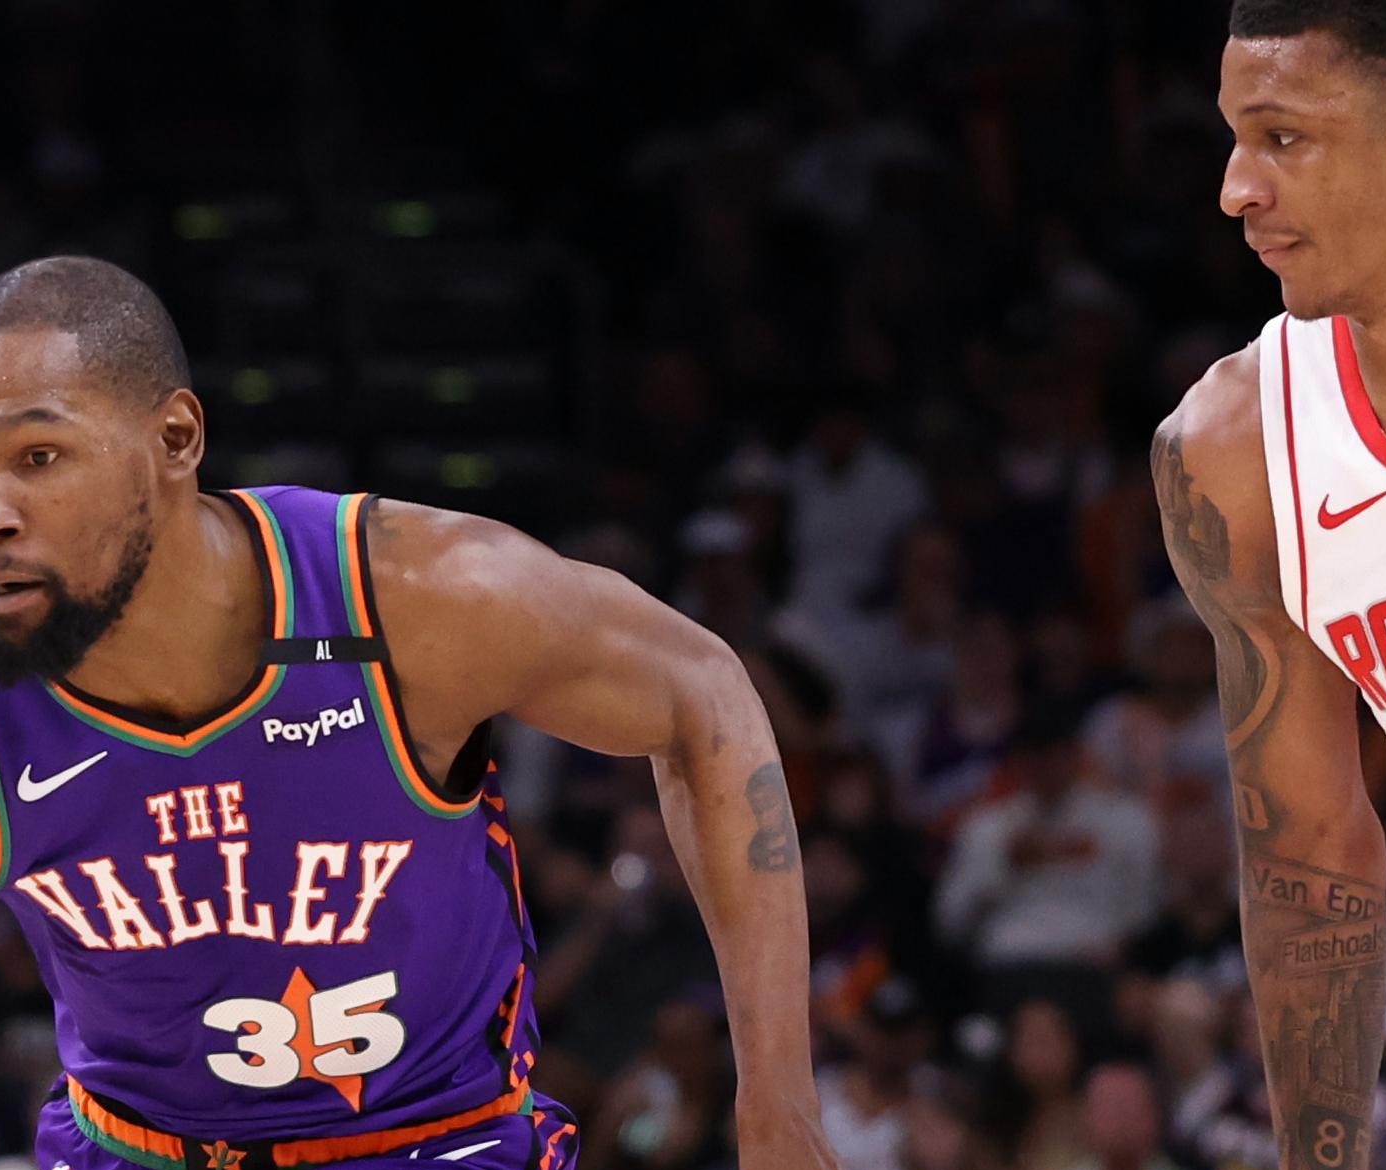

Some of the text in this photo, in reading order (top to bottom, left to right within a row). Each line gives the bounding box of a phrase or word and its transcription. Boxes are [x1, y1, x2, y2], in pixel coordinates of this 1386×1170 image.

[315, 639, 334, 660] AL
[262, 697, 365, 747] PayPal
[146, 781, 249, 844] THE
[14, 840, 413, 951] VALLEY
[1253, 867, 1384, 920] Van Epp
[1284, 924, 1385, 963] Flatshoal
[202, 970, 406, 1089] 35
